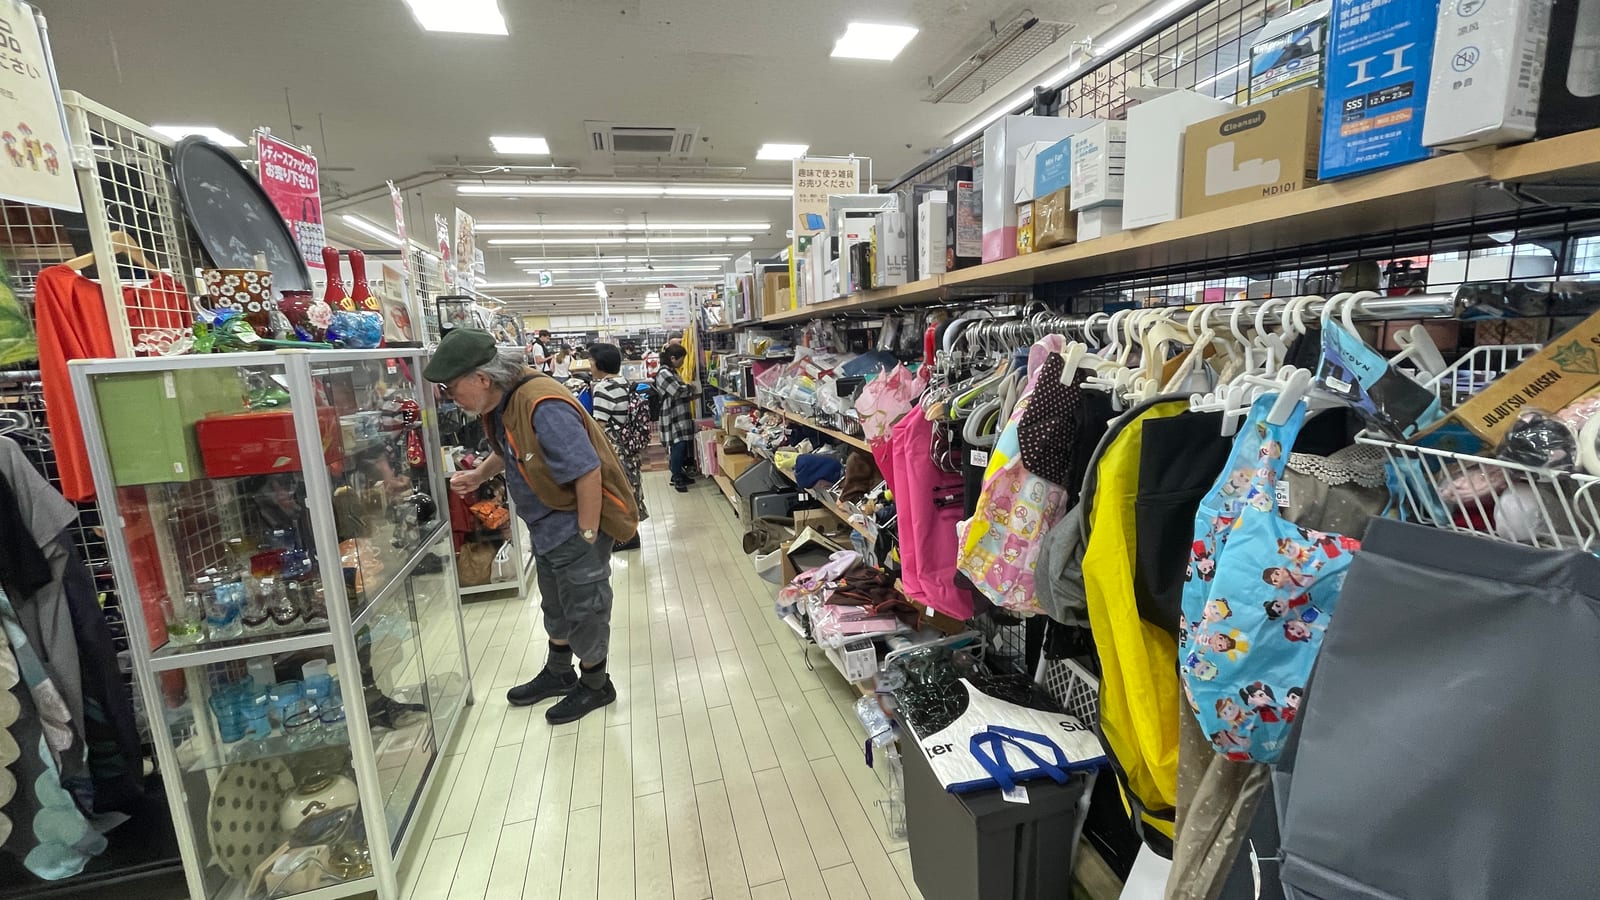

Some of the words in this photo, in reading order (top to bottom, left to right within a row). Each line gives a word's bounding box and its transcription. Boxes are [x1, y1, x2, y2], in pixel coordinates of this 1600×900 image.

[1346, 98, 1363, 111] SSS
[261, 143, 316, 175] レディースファッション
[798, 169, 854, 179] 趣味で使う雑貨
[798, 179, 854, 188] お売りください
[1262, 182, 1296, 197] MD101
[1482, 393, 1527, 428] JUJUTSU
[1521, 369, 1562, 399] KAISEN
